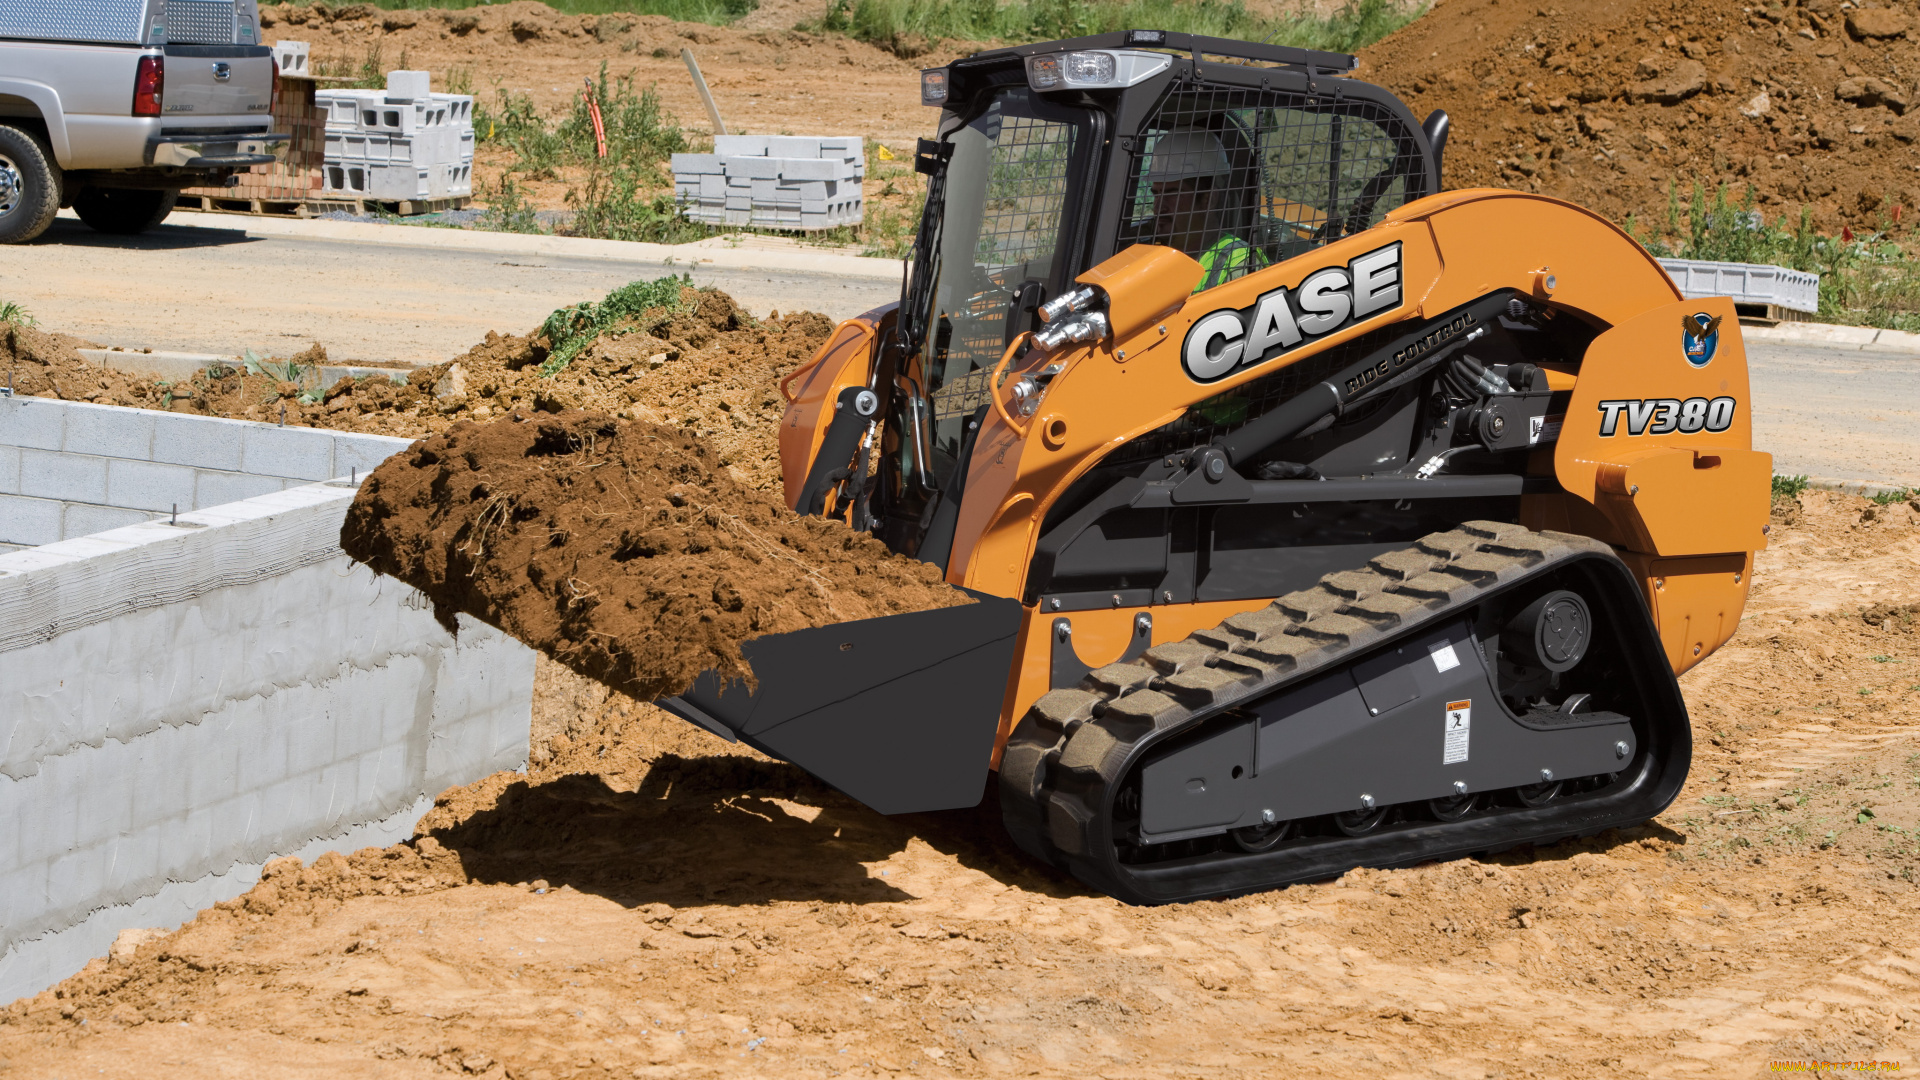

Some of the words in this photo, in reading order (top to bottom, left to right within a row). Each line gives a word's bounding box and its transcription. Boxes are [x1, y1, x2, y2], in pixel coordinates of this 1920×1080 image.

[1182, 241, 1403, 383] CASE
[1344, 360, 1390, 396] RIDE
[1392, 312, 1478, 368] CONTROL
[1599, 395, 1736, 438] TV380
